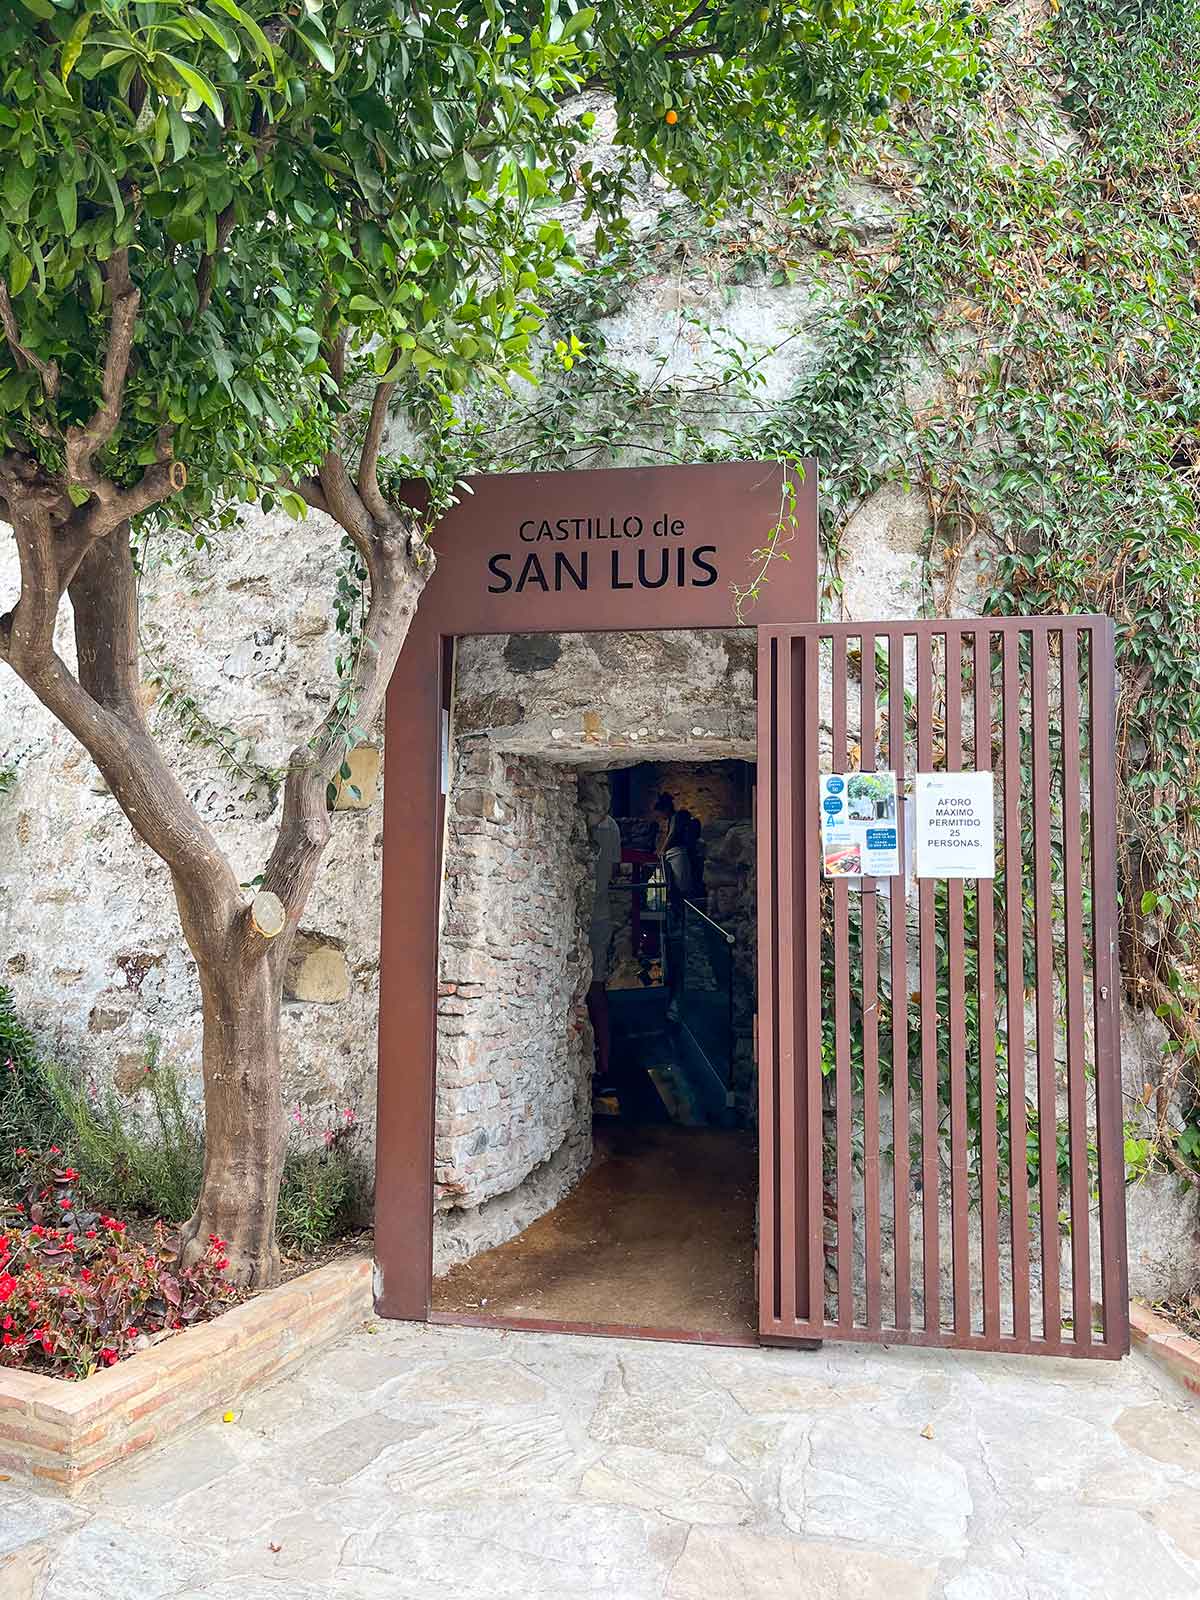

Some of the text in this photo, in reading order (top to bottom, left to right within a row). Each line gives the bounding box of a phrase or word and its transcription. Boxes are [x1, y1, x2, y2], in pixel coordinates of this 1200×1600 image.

[519, 513, 685, 542] CASTILLO de
[487, 545, 719, 594] SAN LUIS
[937, 798, 972, 807] AFORO
[928, 818, 981, 827] PERMITIDO
[949, 829, 961, 837] 25
[927, 839, 983, 848] PERSONAS.
